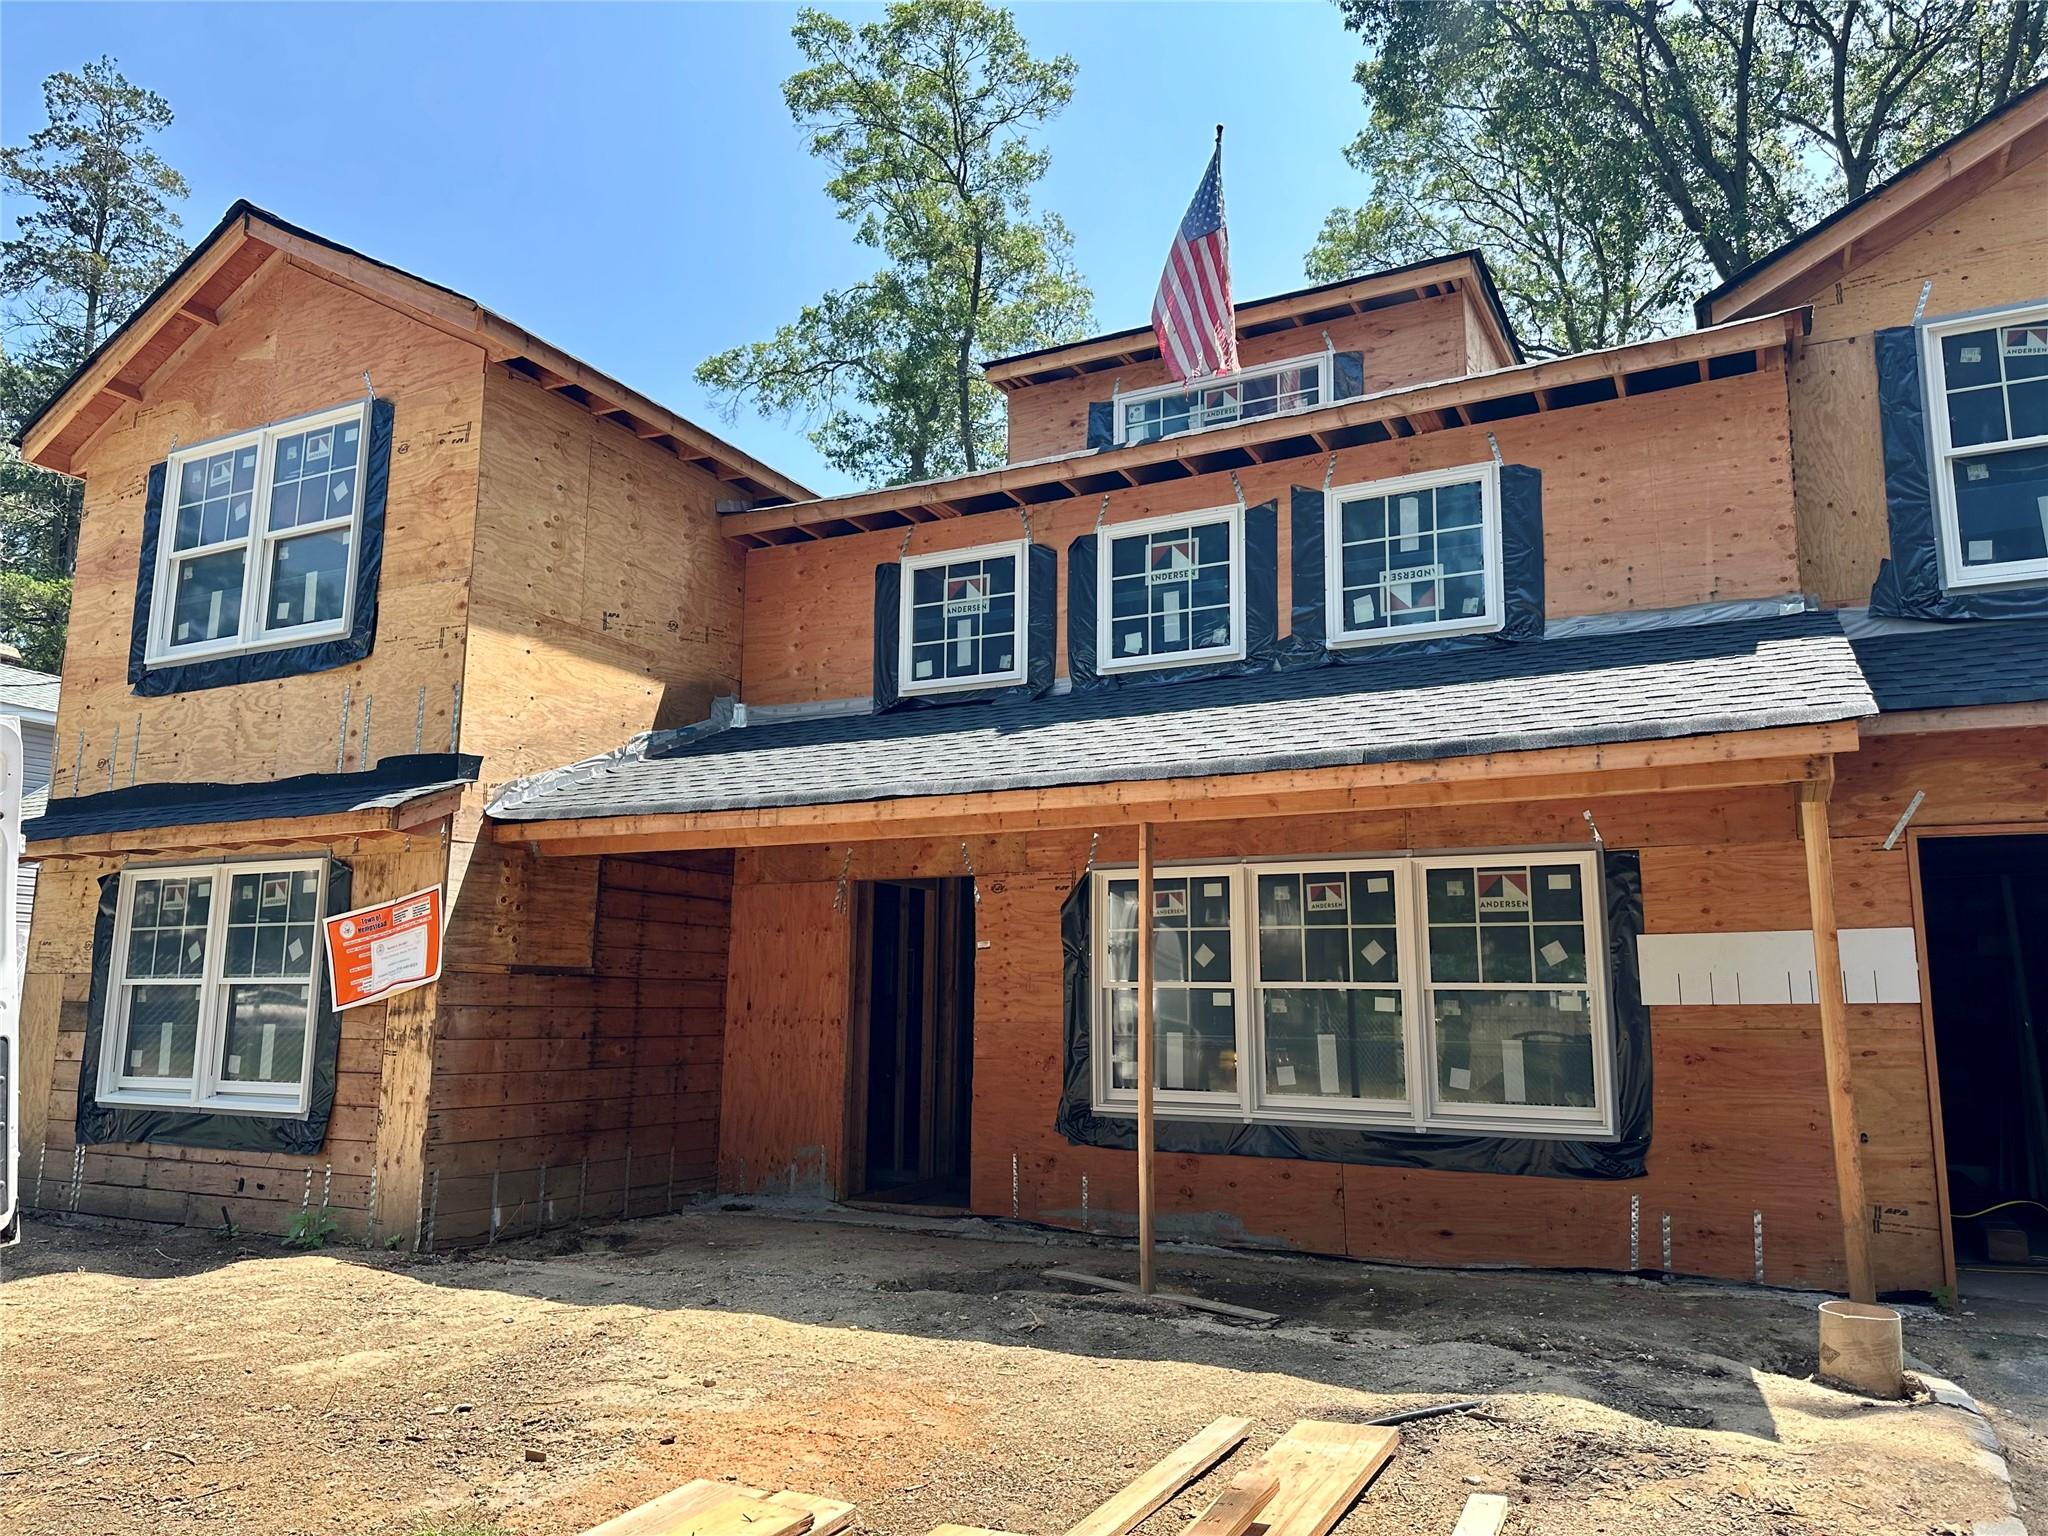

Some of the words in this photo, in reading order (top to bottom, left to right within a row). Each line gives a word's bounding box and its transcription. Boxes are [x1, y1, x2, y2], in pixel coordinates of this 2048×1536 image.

[2006, 347, 2047, 355] ANDERSEN
[1206, 407, 1237, 418] ANDERSE
[1384, 568, 1435, 581] NDERSE
[947, 604, 987, 614] ANDERSEN
[1480, 900, 1528, 908] ANDERSEN
[361, 917, 375, 925] Town
[357, 921, 388, 934] Hempstead
[1884, 1208, 1909, 1216] APA
